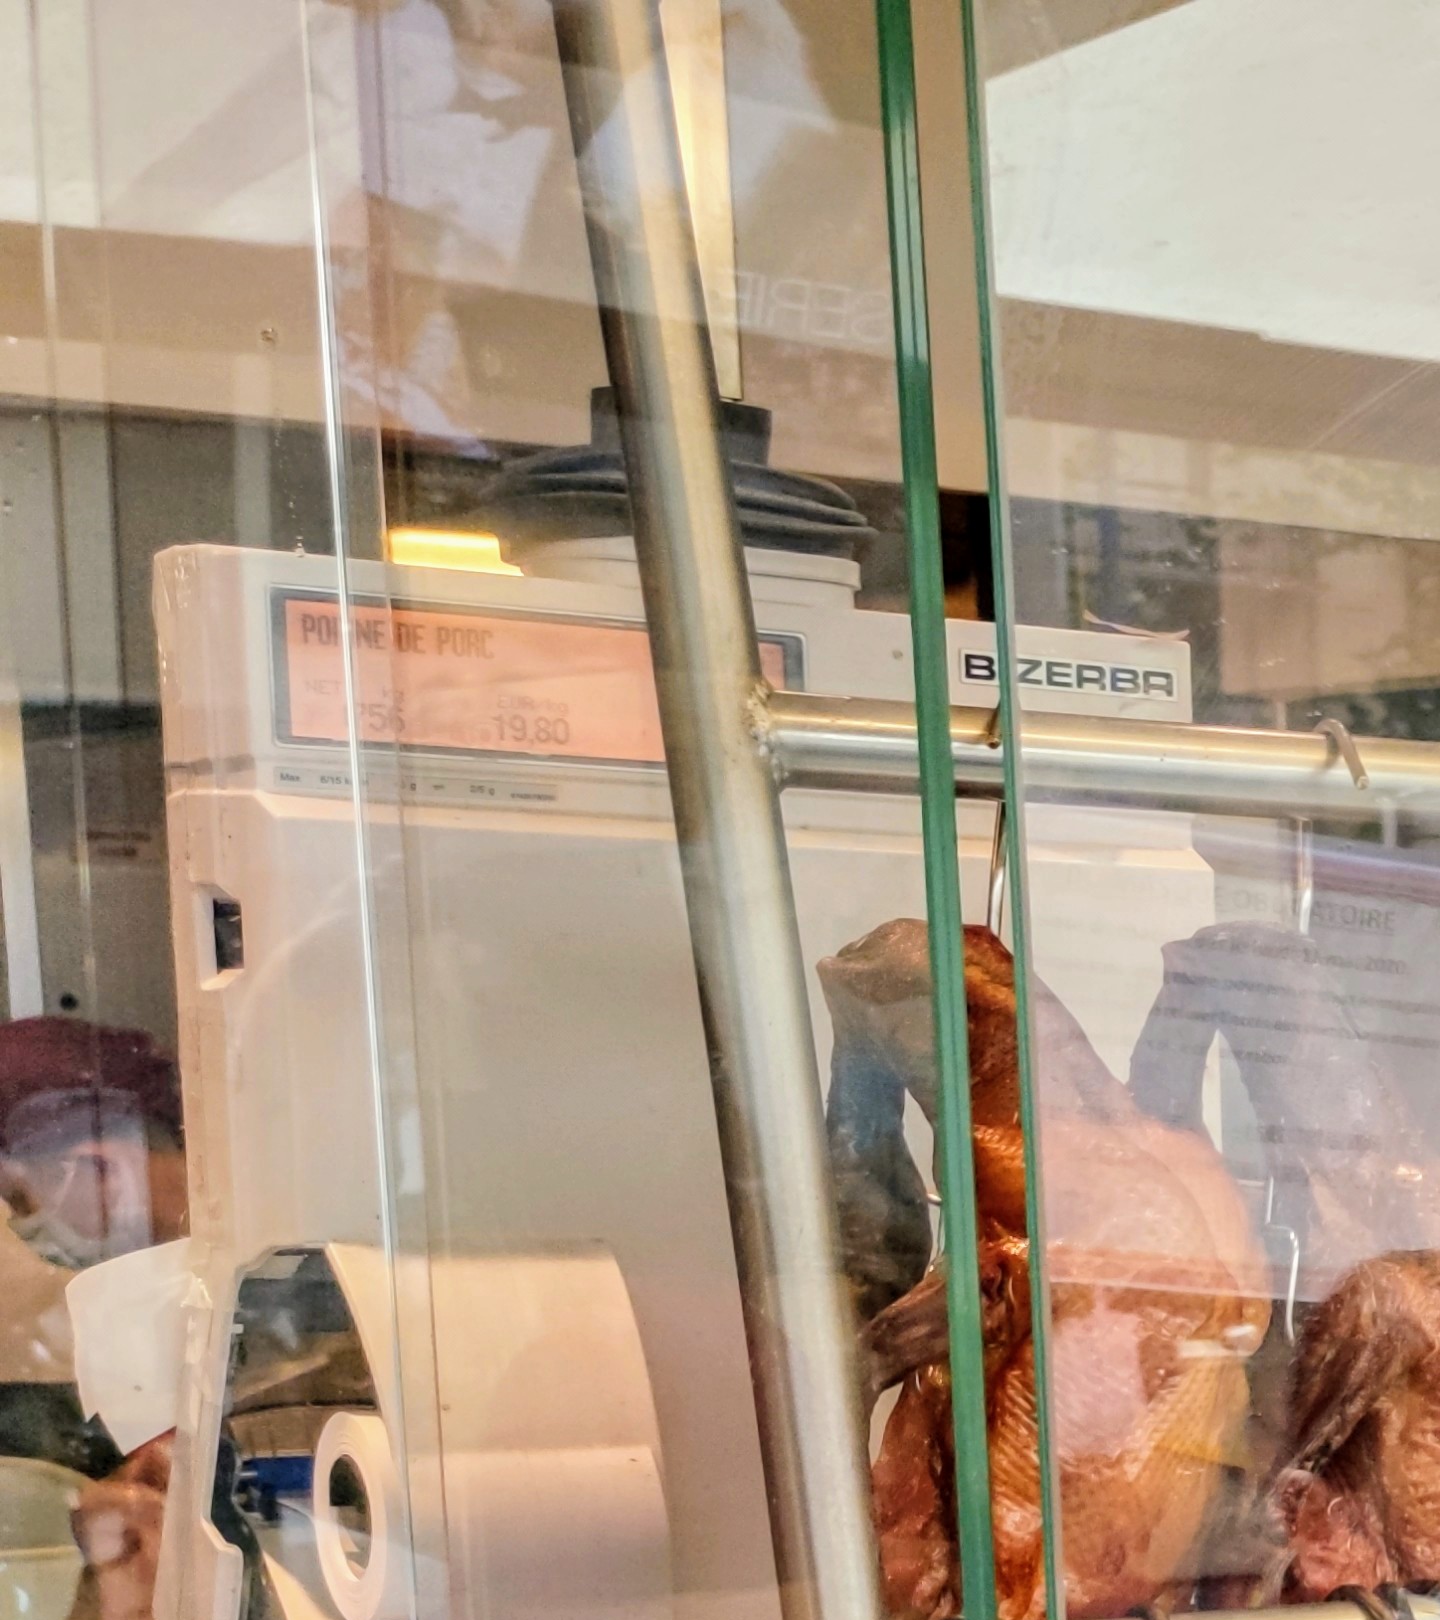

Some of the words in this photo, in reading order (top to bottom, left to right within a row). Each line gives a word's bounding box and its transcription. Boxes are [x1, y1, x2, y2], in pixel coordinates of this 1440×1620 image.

[395, 621, 427, 654] DE
[436, 625, 496, 660] PORC
[964, 653, 1173, 697] BZERBA
[489, 713, 570, 746] 19,80
